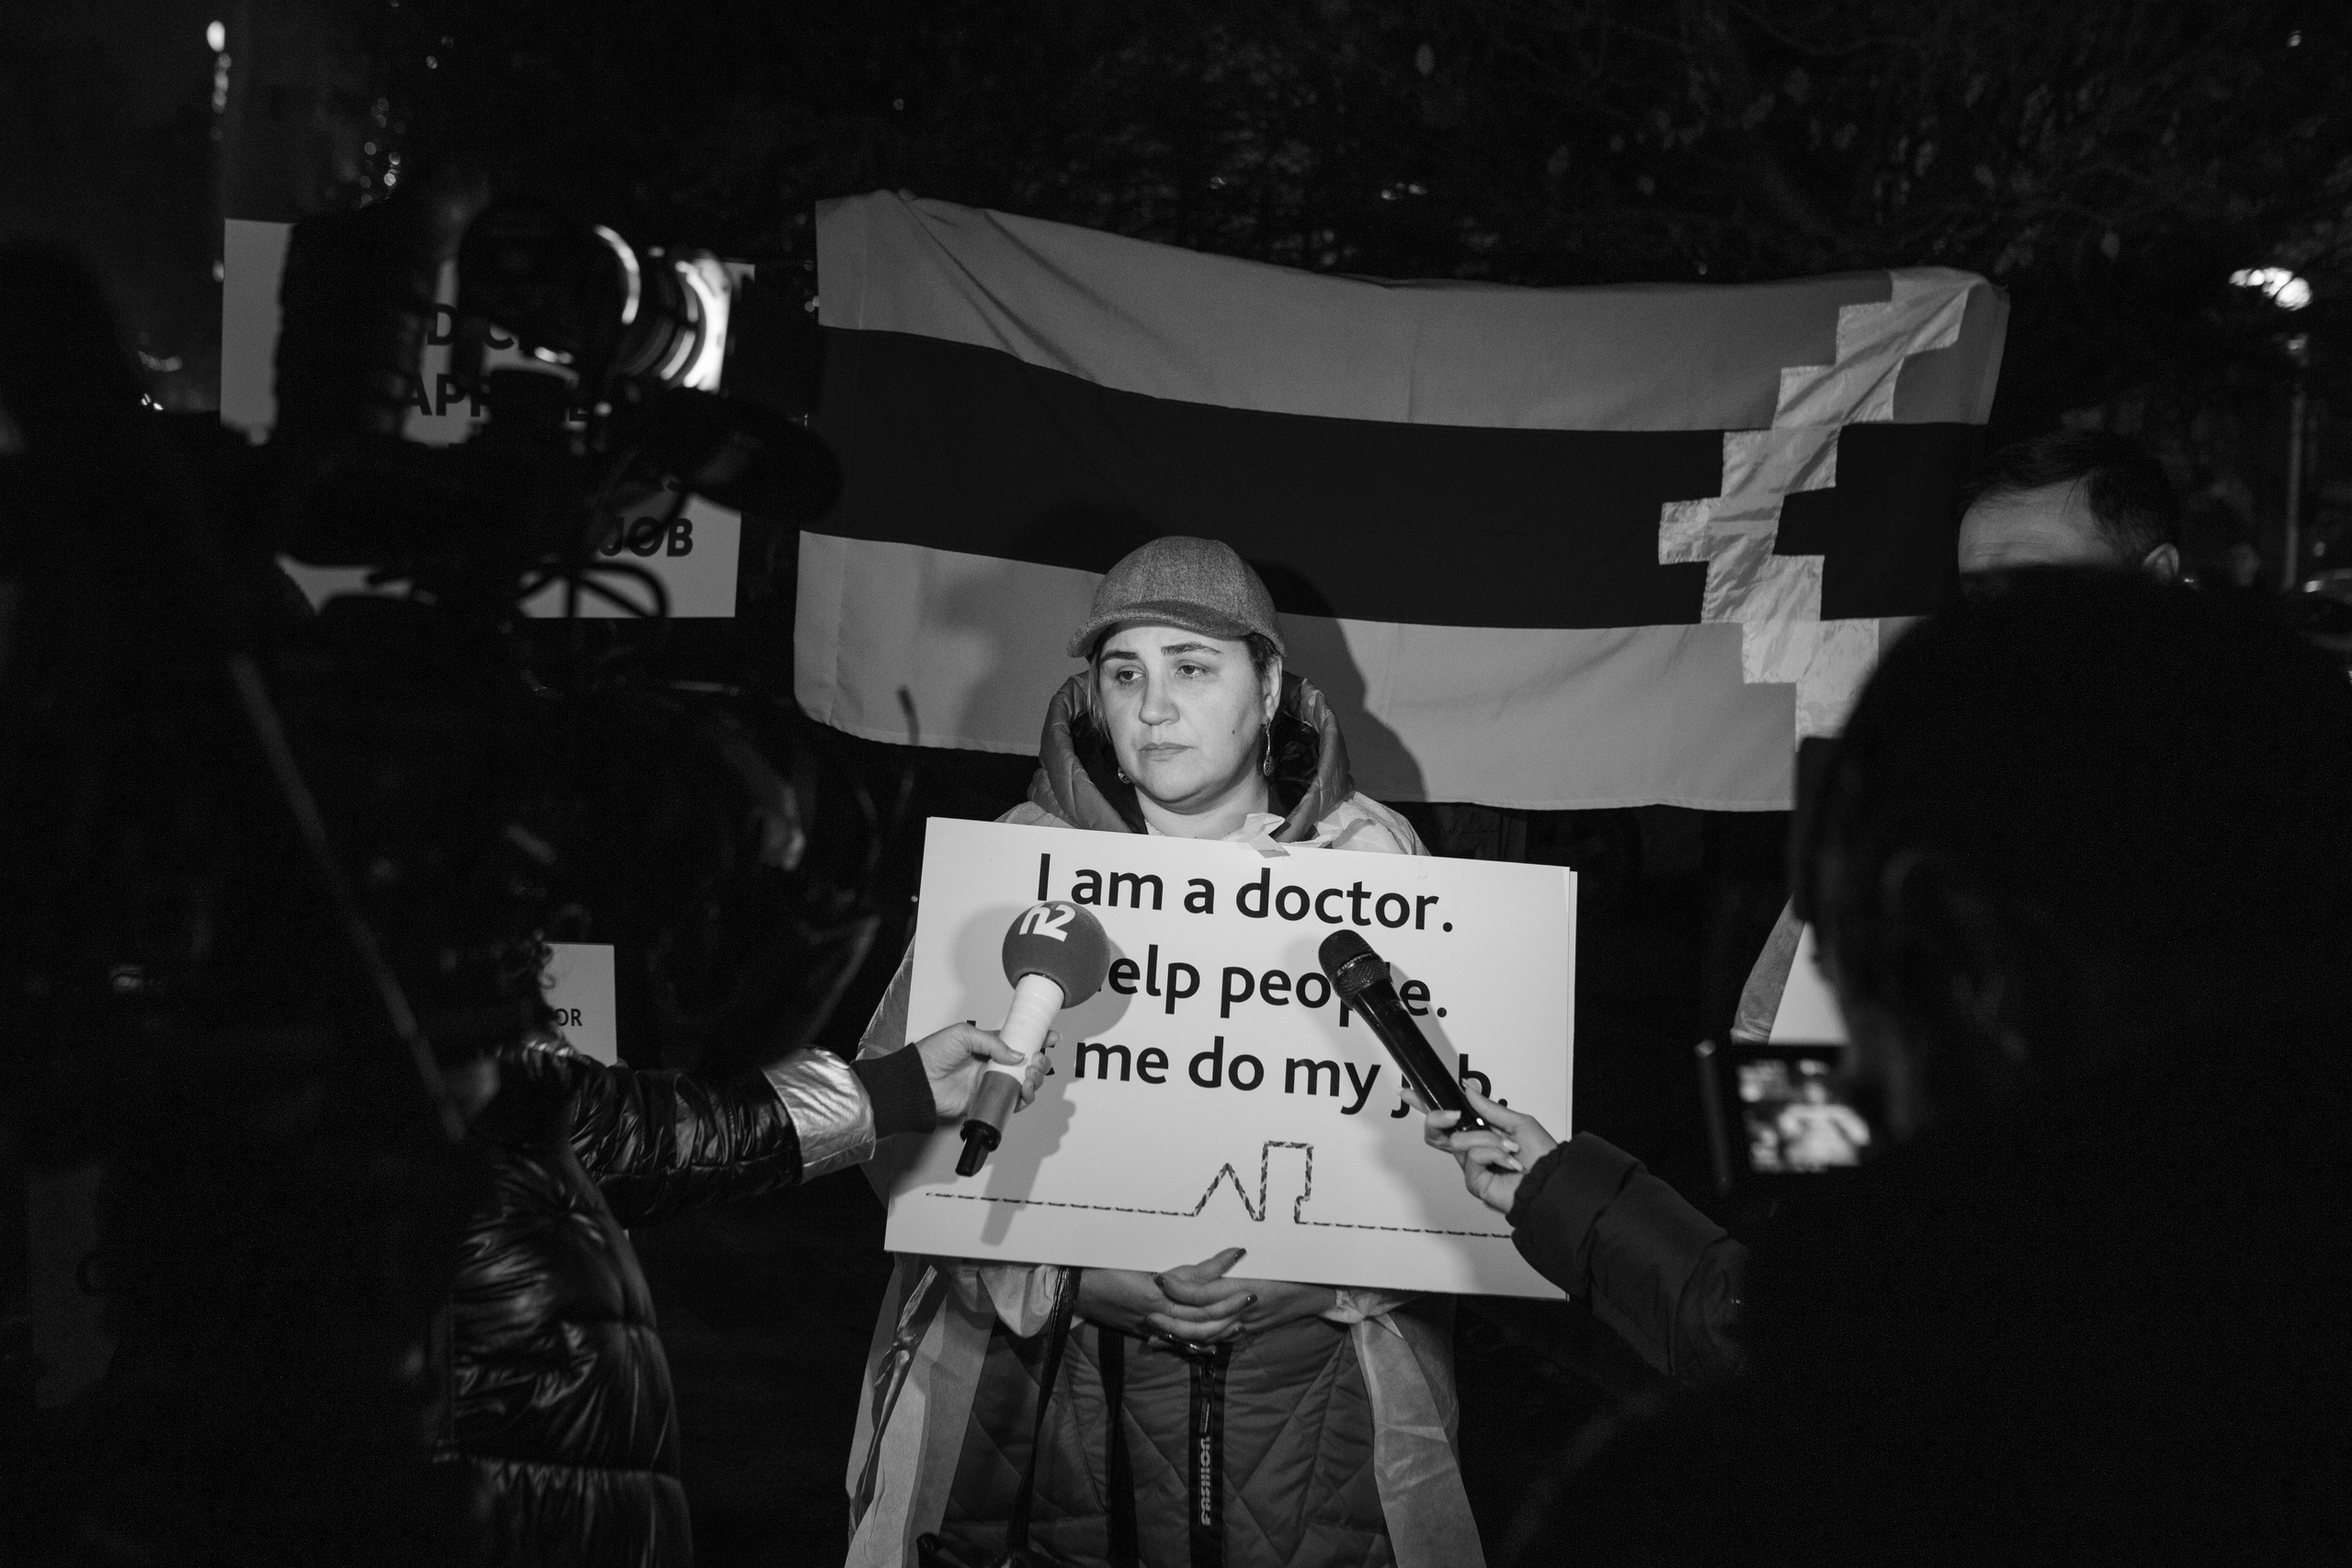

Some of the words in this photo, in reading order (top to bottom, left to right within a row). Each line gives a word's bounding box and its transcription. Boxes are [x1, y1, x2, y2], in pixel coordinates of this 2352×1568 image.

[1038, 853, 1051, 902] I
[1071, 869, 1164, 911] am
[1184, 878, 1215, 915] a
[1236, 868, 1453, 933] doctor.
[1097, 944, 1201, 1015] elp
[1221, 961, 1448, 1028] peoe.
[1074, 1042, 1169, 1085] me
[1188, 1037, 1265, 1091] do
[1285, 1057, 1381, 1115] my
